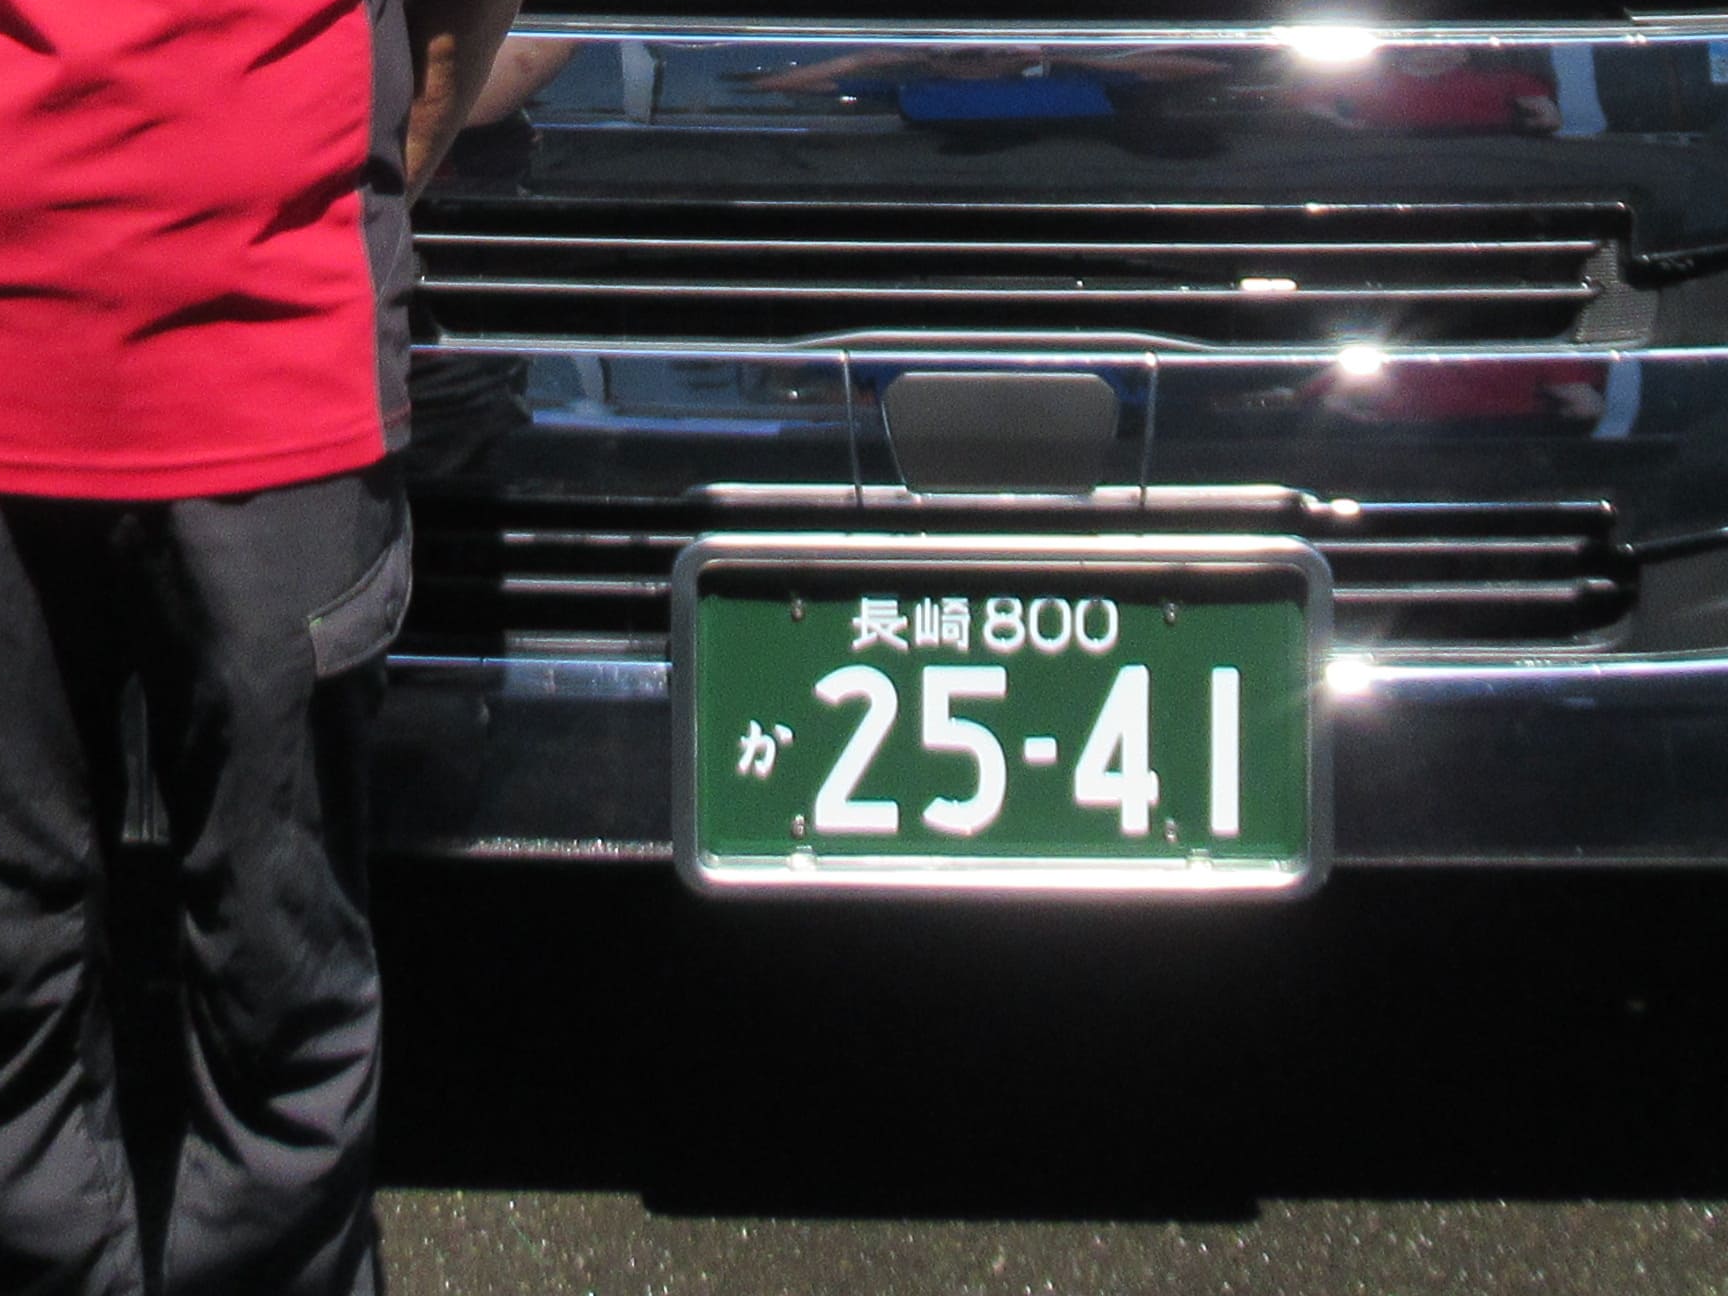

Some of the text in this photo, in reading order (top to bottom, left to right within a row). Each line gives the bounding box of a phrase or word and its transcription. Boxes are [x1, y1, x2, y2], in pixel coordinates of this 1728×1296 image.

[851, 595, 1121, 652] 長崎 800
[736, 664, 1242, 837] か 25-41
